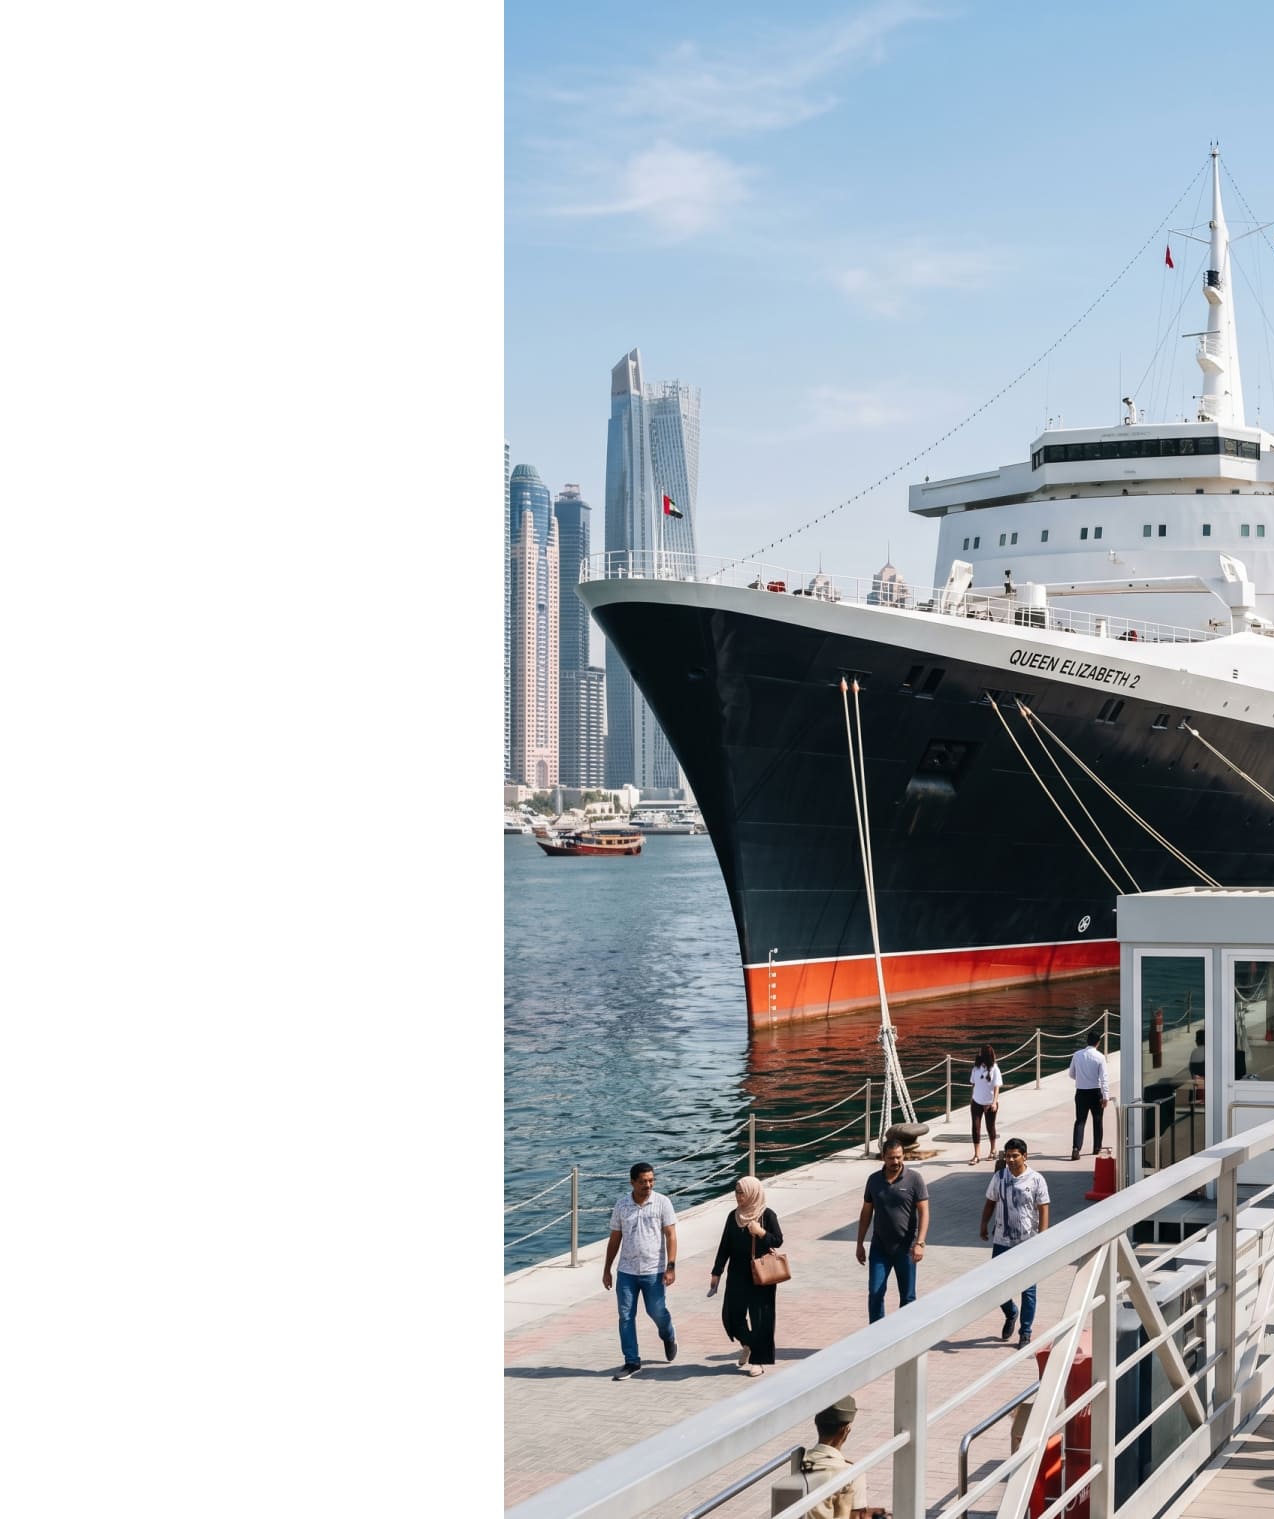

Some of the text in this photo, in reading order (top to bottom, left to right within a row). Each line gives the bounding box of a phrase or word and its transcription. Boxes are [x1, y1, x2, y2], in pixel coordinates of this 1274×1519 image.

[1009, 649, 1141, 689] QUEEN ELIZABETH 2
